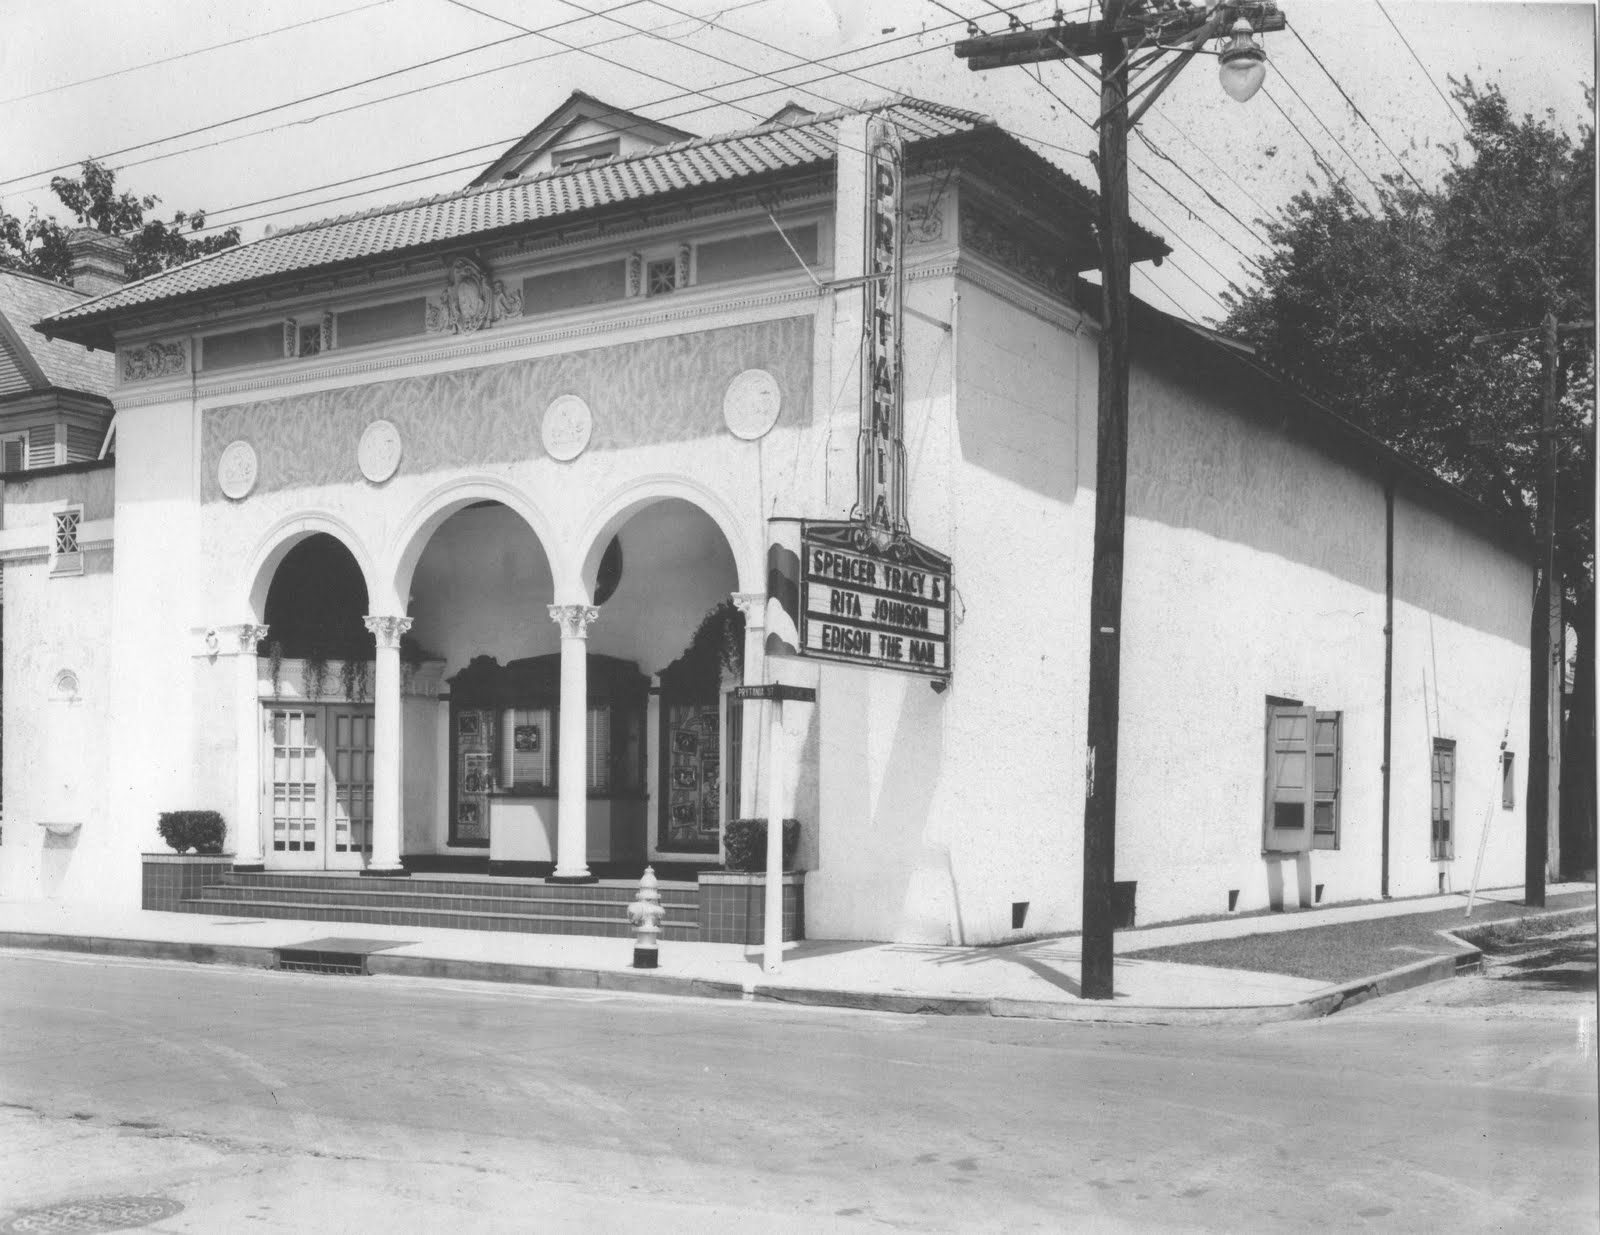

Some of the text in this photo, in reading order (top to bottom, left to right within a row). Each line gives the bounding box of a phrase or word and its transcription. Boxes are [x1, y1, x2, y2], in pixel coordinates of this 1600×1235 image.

[873, 163, 894, 531] PRYTANIA
[814, 550, 876, 584] SPENCER
[884, 565, 925, 594] TRACY
[831, 589, 928, 629] RITA JOHNSON
[822, 624, 935, 664] EDISON THE MAN
[738, 687, 764, 697] PRYTANIA
